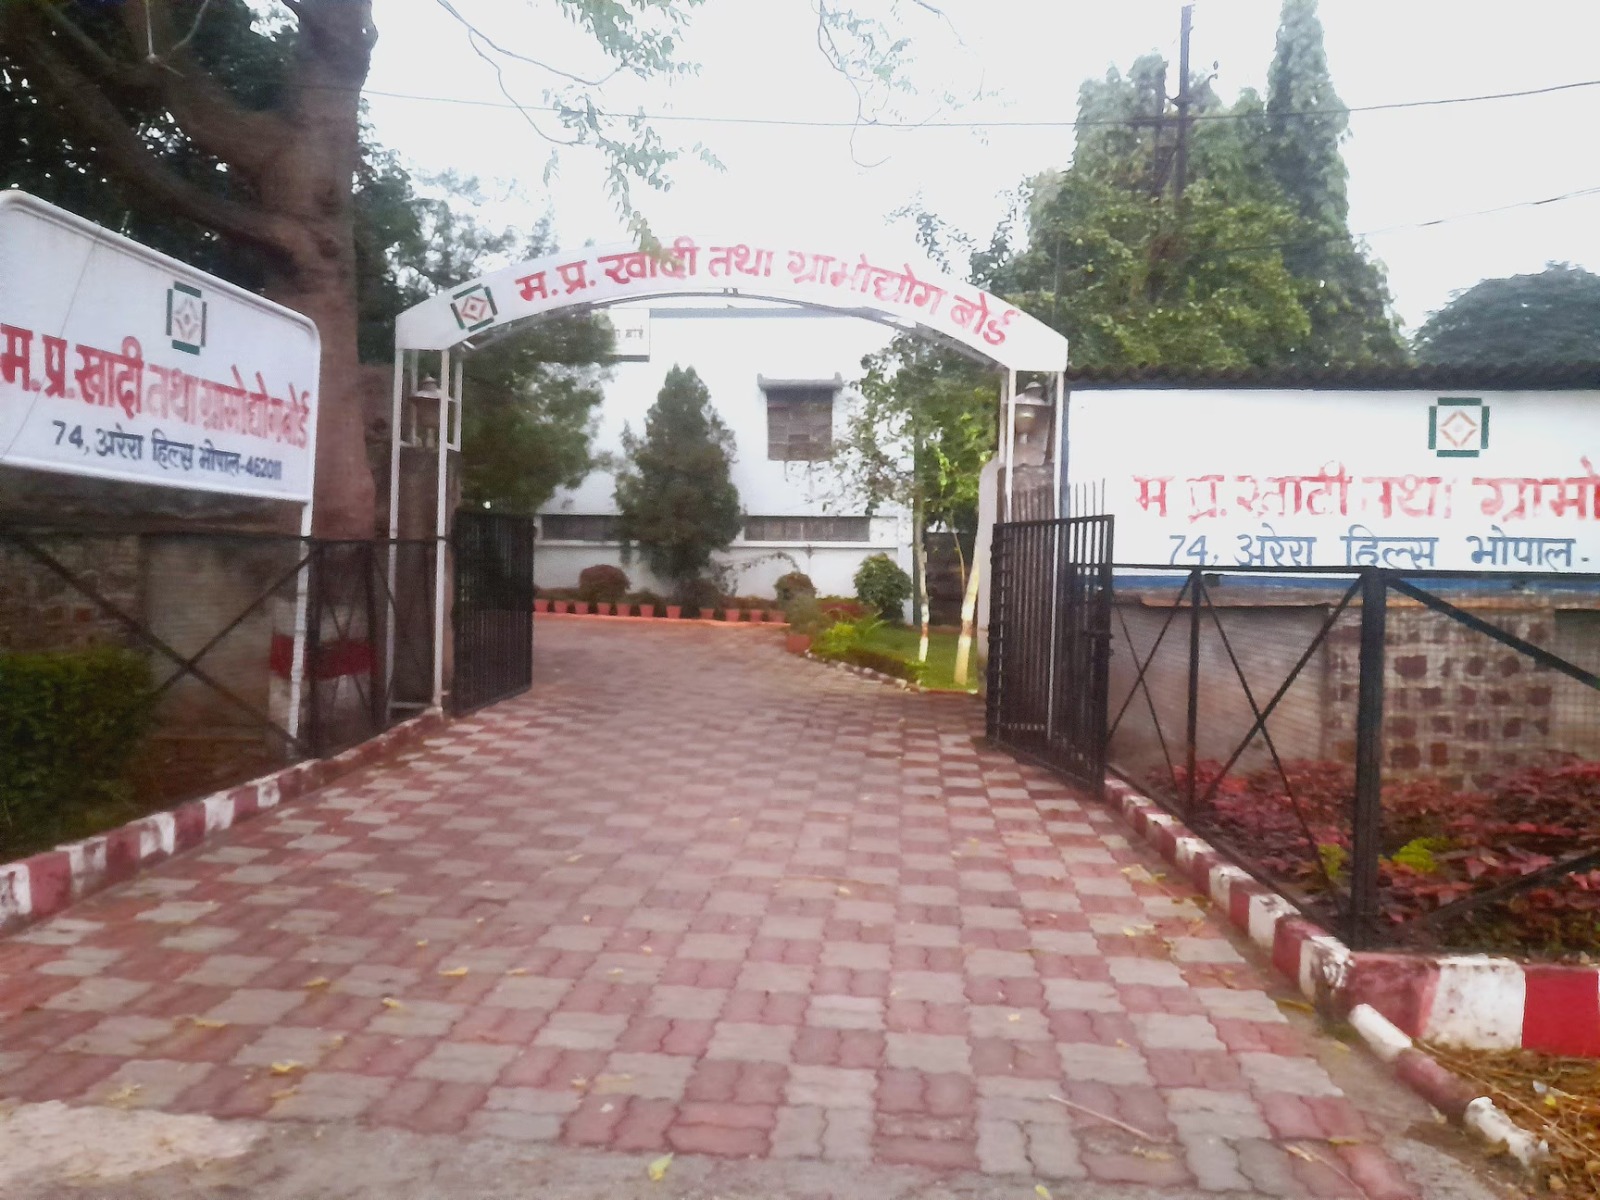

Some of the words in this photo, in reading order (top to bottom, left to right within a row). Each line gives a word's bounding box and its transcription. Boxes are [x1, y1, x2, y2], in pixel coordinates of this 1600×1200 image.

[708, 243, 774, 277] तथा
[787, 252, 948, 316] ग्रामोद्योग
[950, 291, 1021, 346] बोर्ड
[74, 336, 144, 419] खादी
[147, 363, 200, 426] तथा
[95, 422, 144, 460] अरेरा
[151, 428, 194, 471] हिल्स
[1234, 522, 1317, 566] अरेरा
[1340, 524, 1439, 570] हिल्स
